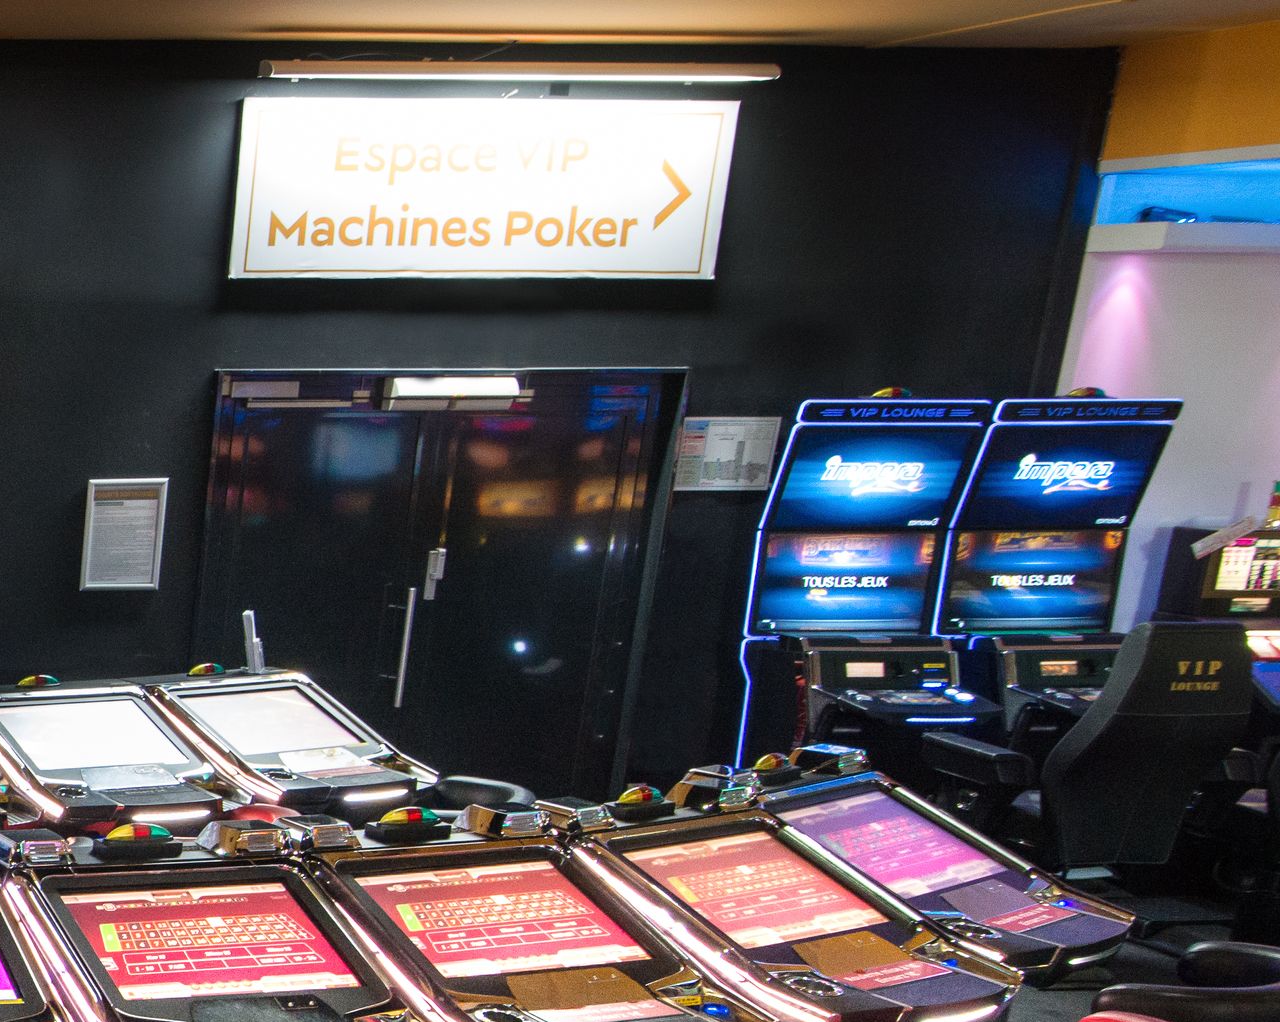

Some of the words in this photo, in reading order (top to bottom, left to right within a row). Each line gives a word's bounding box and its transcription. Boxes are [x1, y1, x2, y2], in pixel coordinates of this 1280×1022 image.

[334, 137, 497, 186] Espace
[516, 137, 590, 172] VIP
[267, 204, 491, 248] Machines
[503, 206, 638, 248] Poker
[850, 408, 878, 418] VIP
[882, 408, 945, 418] LOUNGE
[1046, 407, 1075, 417] VIP
[1077, 407, 1138, 417] LOUNGE
[803, 577, 835, 588] TOUS
[836, 577, 856, 588] LES
[857, 577, 888, 588] JEUX
[991, 575, 1022, 586] TOUS
[1022, 575, 1043, 586] LES
[1044, 575, 1075, 586] JEUX
[1177, 660, 1223, 675] VIP
[1170, 681, 1220, 691] LOUNGE
